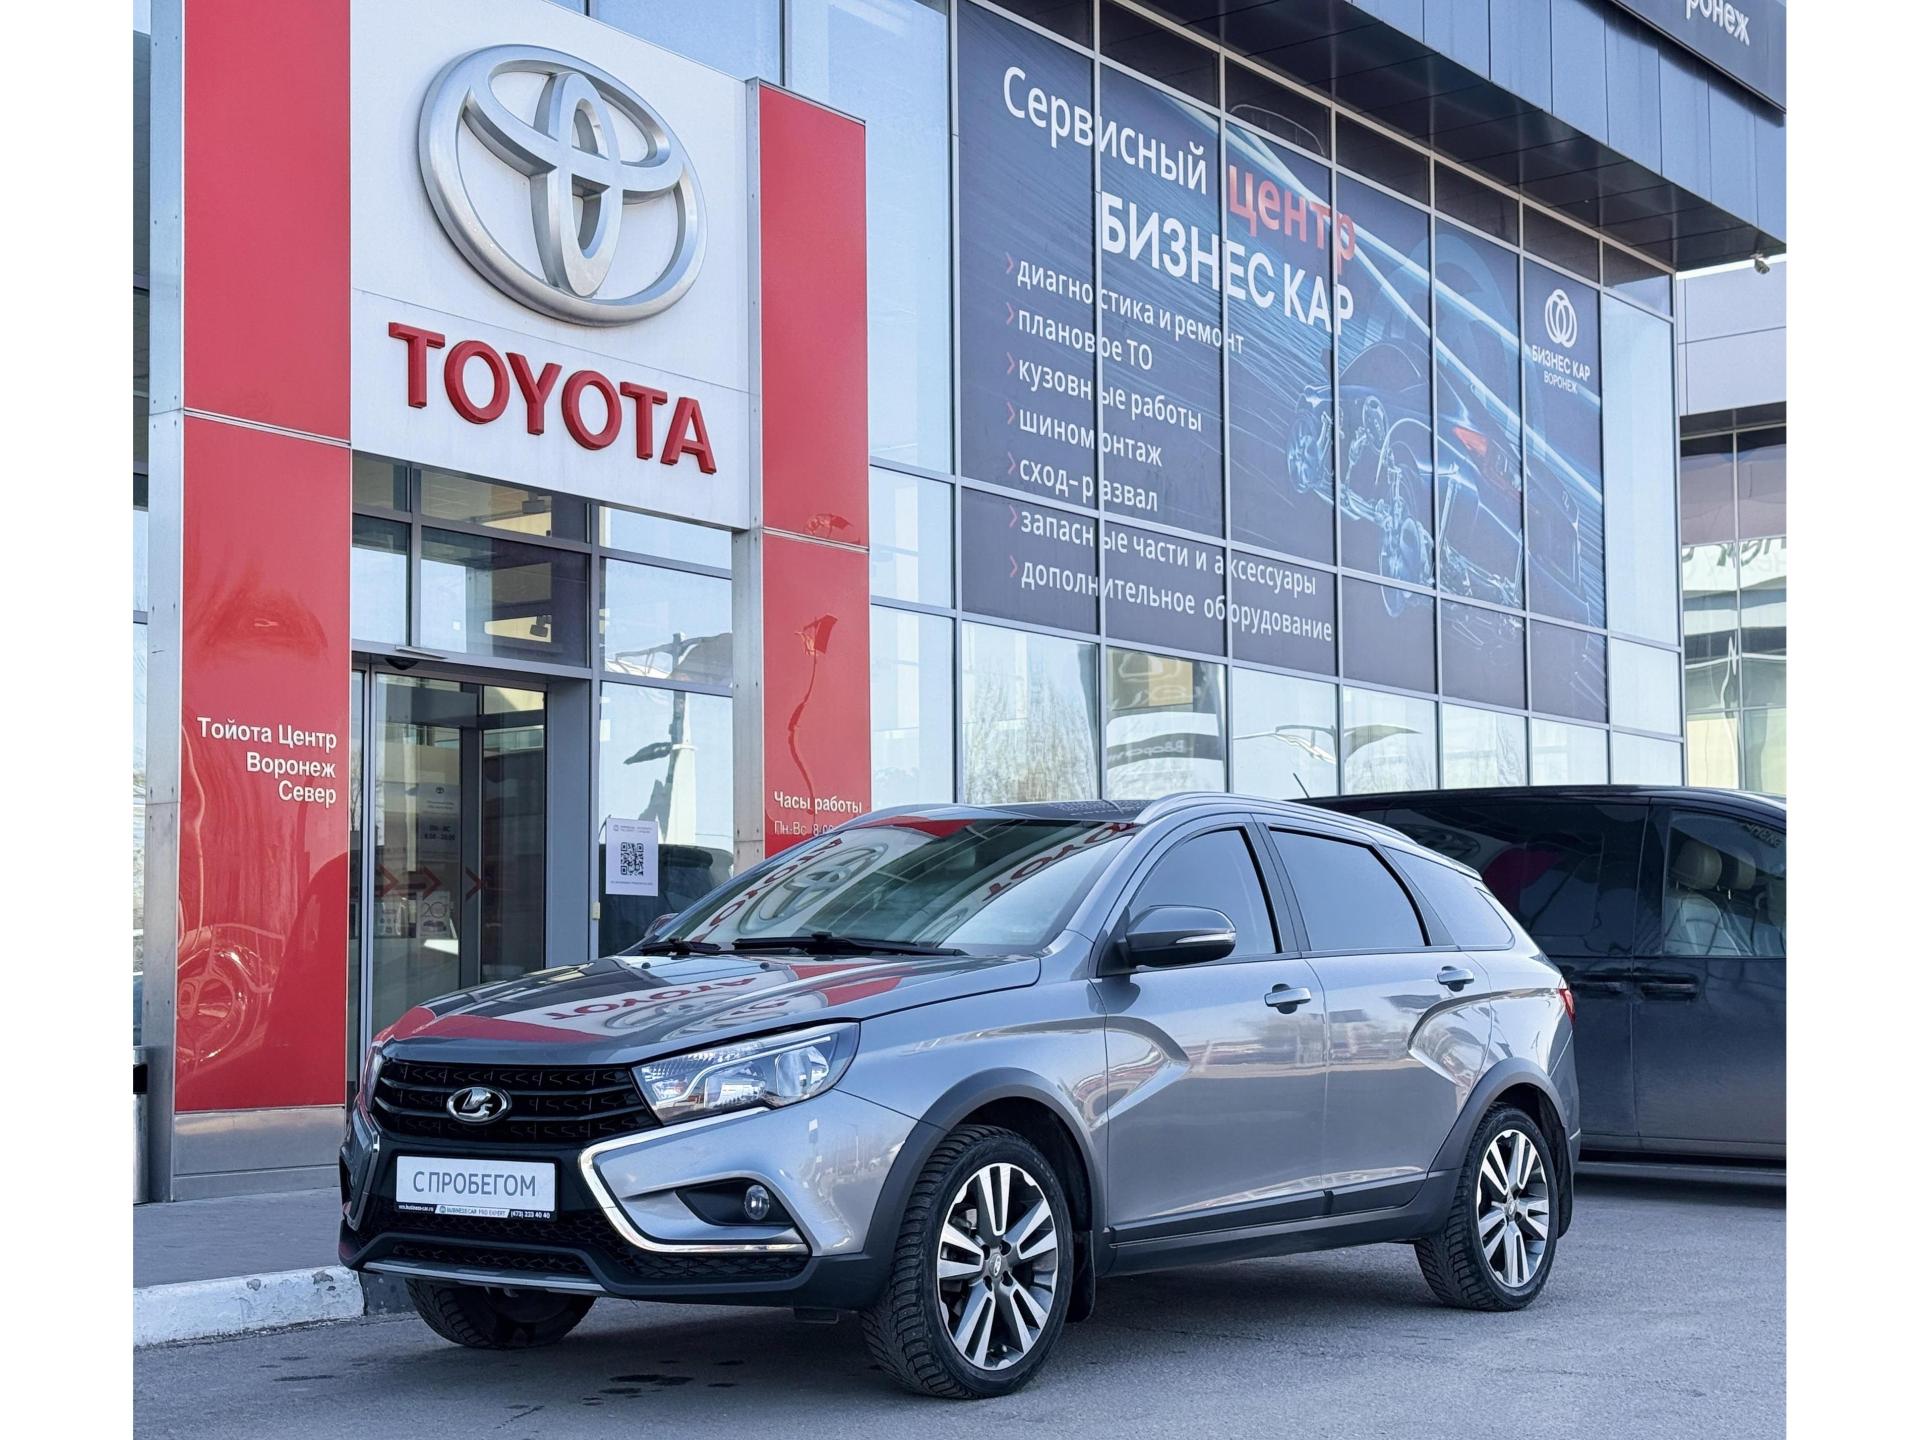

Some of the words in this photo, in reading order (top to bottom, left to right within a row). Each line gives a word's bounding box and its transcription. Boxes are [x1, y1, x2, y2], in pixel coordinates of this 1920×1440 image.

[1002, 66, 1208, 195] Сервисный
[1228, 163, 1356, 275] центр
[1102, 190, 1275, 309] БИЗНЕС
[1284, 262, 1354, 338] КАР
[1018, 260, 1154, 325] диагностика
[1160, 308, 1171, 331] и
[1175, 314, 1244, 354] ремонт
[1018, 309, 1122, 362] плановое
[1126, 339, 1153, 370] ТО
[1532, 344, 1571, 374] БИЗНЕС
[1572, 360, 1591, 382] КАР
[389, 322, 717, 475] TOYOTA
[1019, 359, 1126, 410] кузовные
[1131, 393, 1202, 432] работы
[1543, 370, 1578, 394] ВОРОНЕЖ
[1019, 409, 1162, 467] шиномонтаж
[1021, 511, 1128, 554] запасные
[1133, 535, 1188, 566] части
[1195, 547, 1207, 572] и
[1214, 554, 1316, 600] аксессуары
[1021, 561, 1196, 615] дополнительное
[1204, 594, 1332, 643] оборудование
[197, 716, 272, 743] Тойота
[278, 724, 337, 753] Центр
[246, 752, 336, 779] Воронеж
[278, 780, 336, 809] Север
[774, 791, 811, 810] Часы
[814, 796, 862, 815] работы
[412, 1170, 425, 1193] С
[428, 1171, 536, 1197] ПРОБЕГОМ
